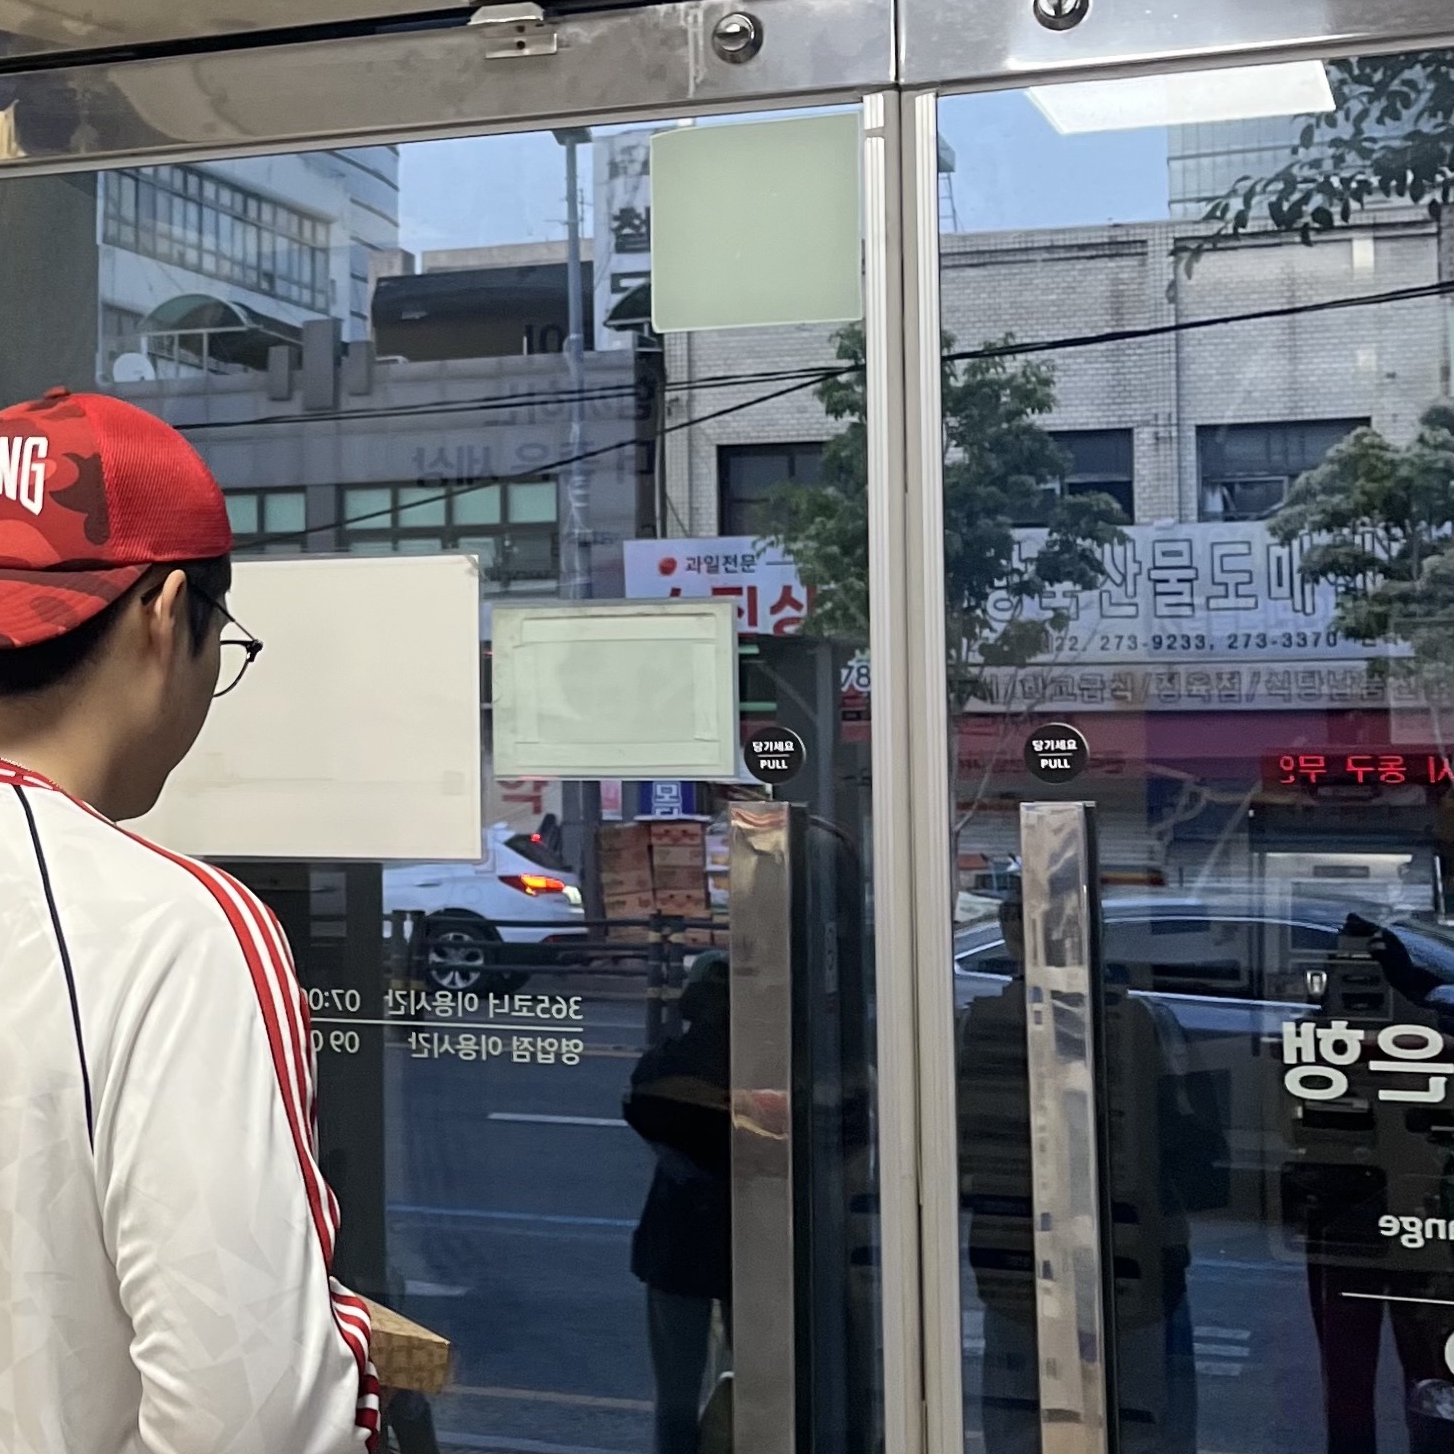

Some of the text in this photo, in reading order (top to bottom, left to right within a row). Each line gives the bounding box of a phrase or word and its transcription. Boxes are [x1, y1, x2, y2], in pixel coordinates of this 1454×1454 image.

[685, 554, 757, 575] 과일전문
[1101, 633, 1214, 653] 273-9233,
[1227, 631, 1338, 650] 273-3370
[752, 740, 794, 753] 당기세요
[1032, 739, 1078, 752] 당기세요
[760, 759, 788, 770] PULL
[1040, 758, 1071, 769] PULL
